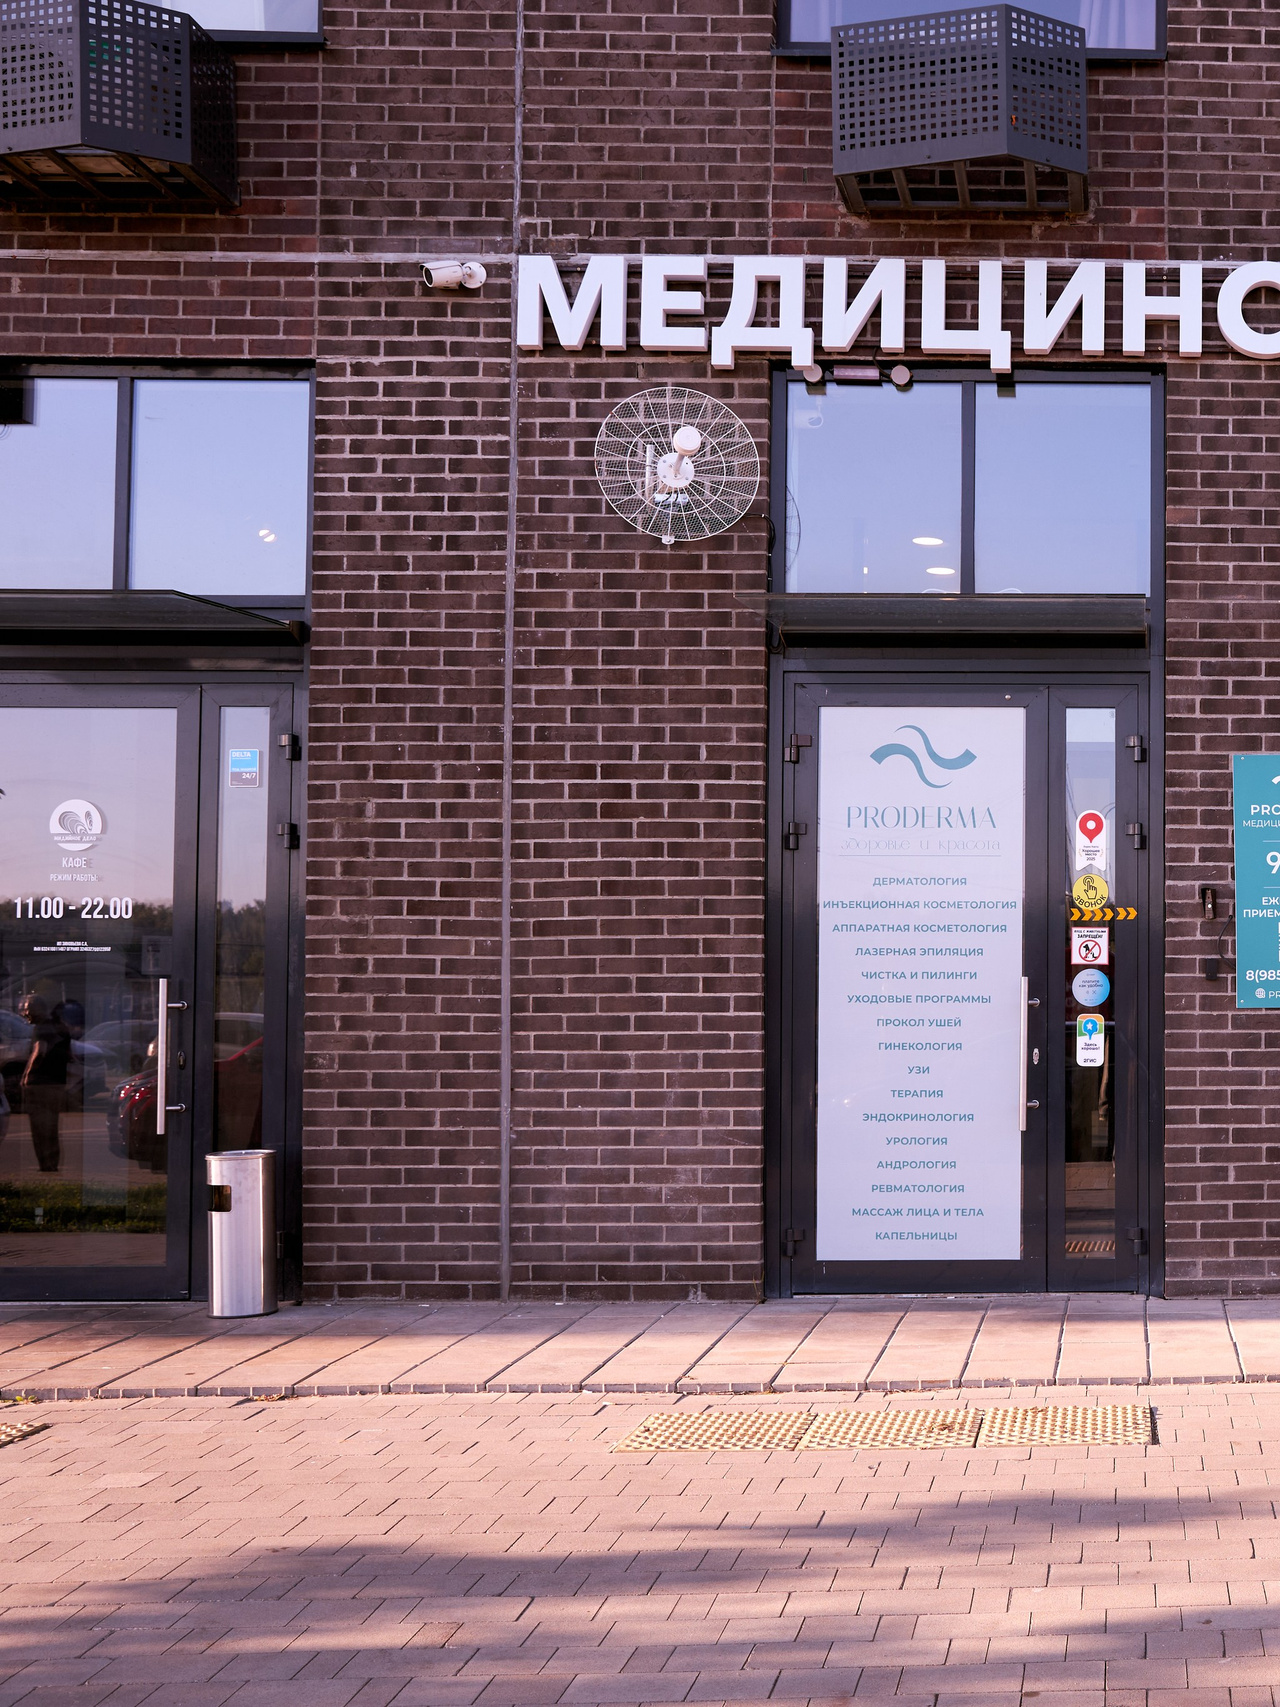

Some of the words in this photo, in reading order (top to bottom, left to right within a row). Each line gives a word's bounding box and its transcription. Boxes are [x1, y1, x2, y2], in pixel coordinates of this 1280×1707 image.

[848, 807, 995, 828] PRODERMA
[841, 838, 910, 853] здоровье
[920, 840, 928, 850] и
[938, 839, 1000, 853] красота
[62, 858, 86, 868] КАФЕ
[50, 873, 71, 881] РЕЖИМ
[873, 878, 966, 886] ДЕРМАТОЛОГИЯ
[823, 901, 919, 909] ИНЪЕКЦИОННАЯ
[924, 901, 1016, 909] КОСМЕТОЛОГИЯ
[1074, 895, 1106, 908] ЗВОНОК
[14, 897, 64, 919] 11.00
[81, 897, 133, 919] 22.00
[832, 924, 909, 932] АППАРАТНАЯ
[914, 924, 1006, 932] КОСМЕТОЛОГИЯ
[920, 948, 983, 957] ЭПИЛЯЦИЯ
[862, 971, 906, 979] ЧИСТКА
[848, 995, 912, 1004] УХОДОВЫЕ
[916, 995, 990, 1003] ПРОГРАММЫ
[929, 1017, 961, 1027] УШЕЙ
[908, 1066, 929, 1074] УЗИ
[892, 1090, 943, 1098] ТЕРАПИЯ
[863, 1113, 974, 1122] ЭНДОКРИНОЛОГИЯ
[886, 1137, 947, 1145] УРОЛОГИЯ
[877, 1161, 956, 1170] АНДРОЛОГИЯ
[852, 1208, 903, 1216] МАССАЖ
[907, 1208, 939, 1217] ЛИЦА
[954, 1208, 984, 1217] ТЕЛА
[876, 1232, 957, 1241] КАПЕЛЬНИЦЫ
